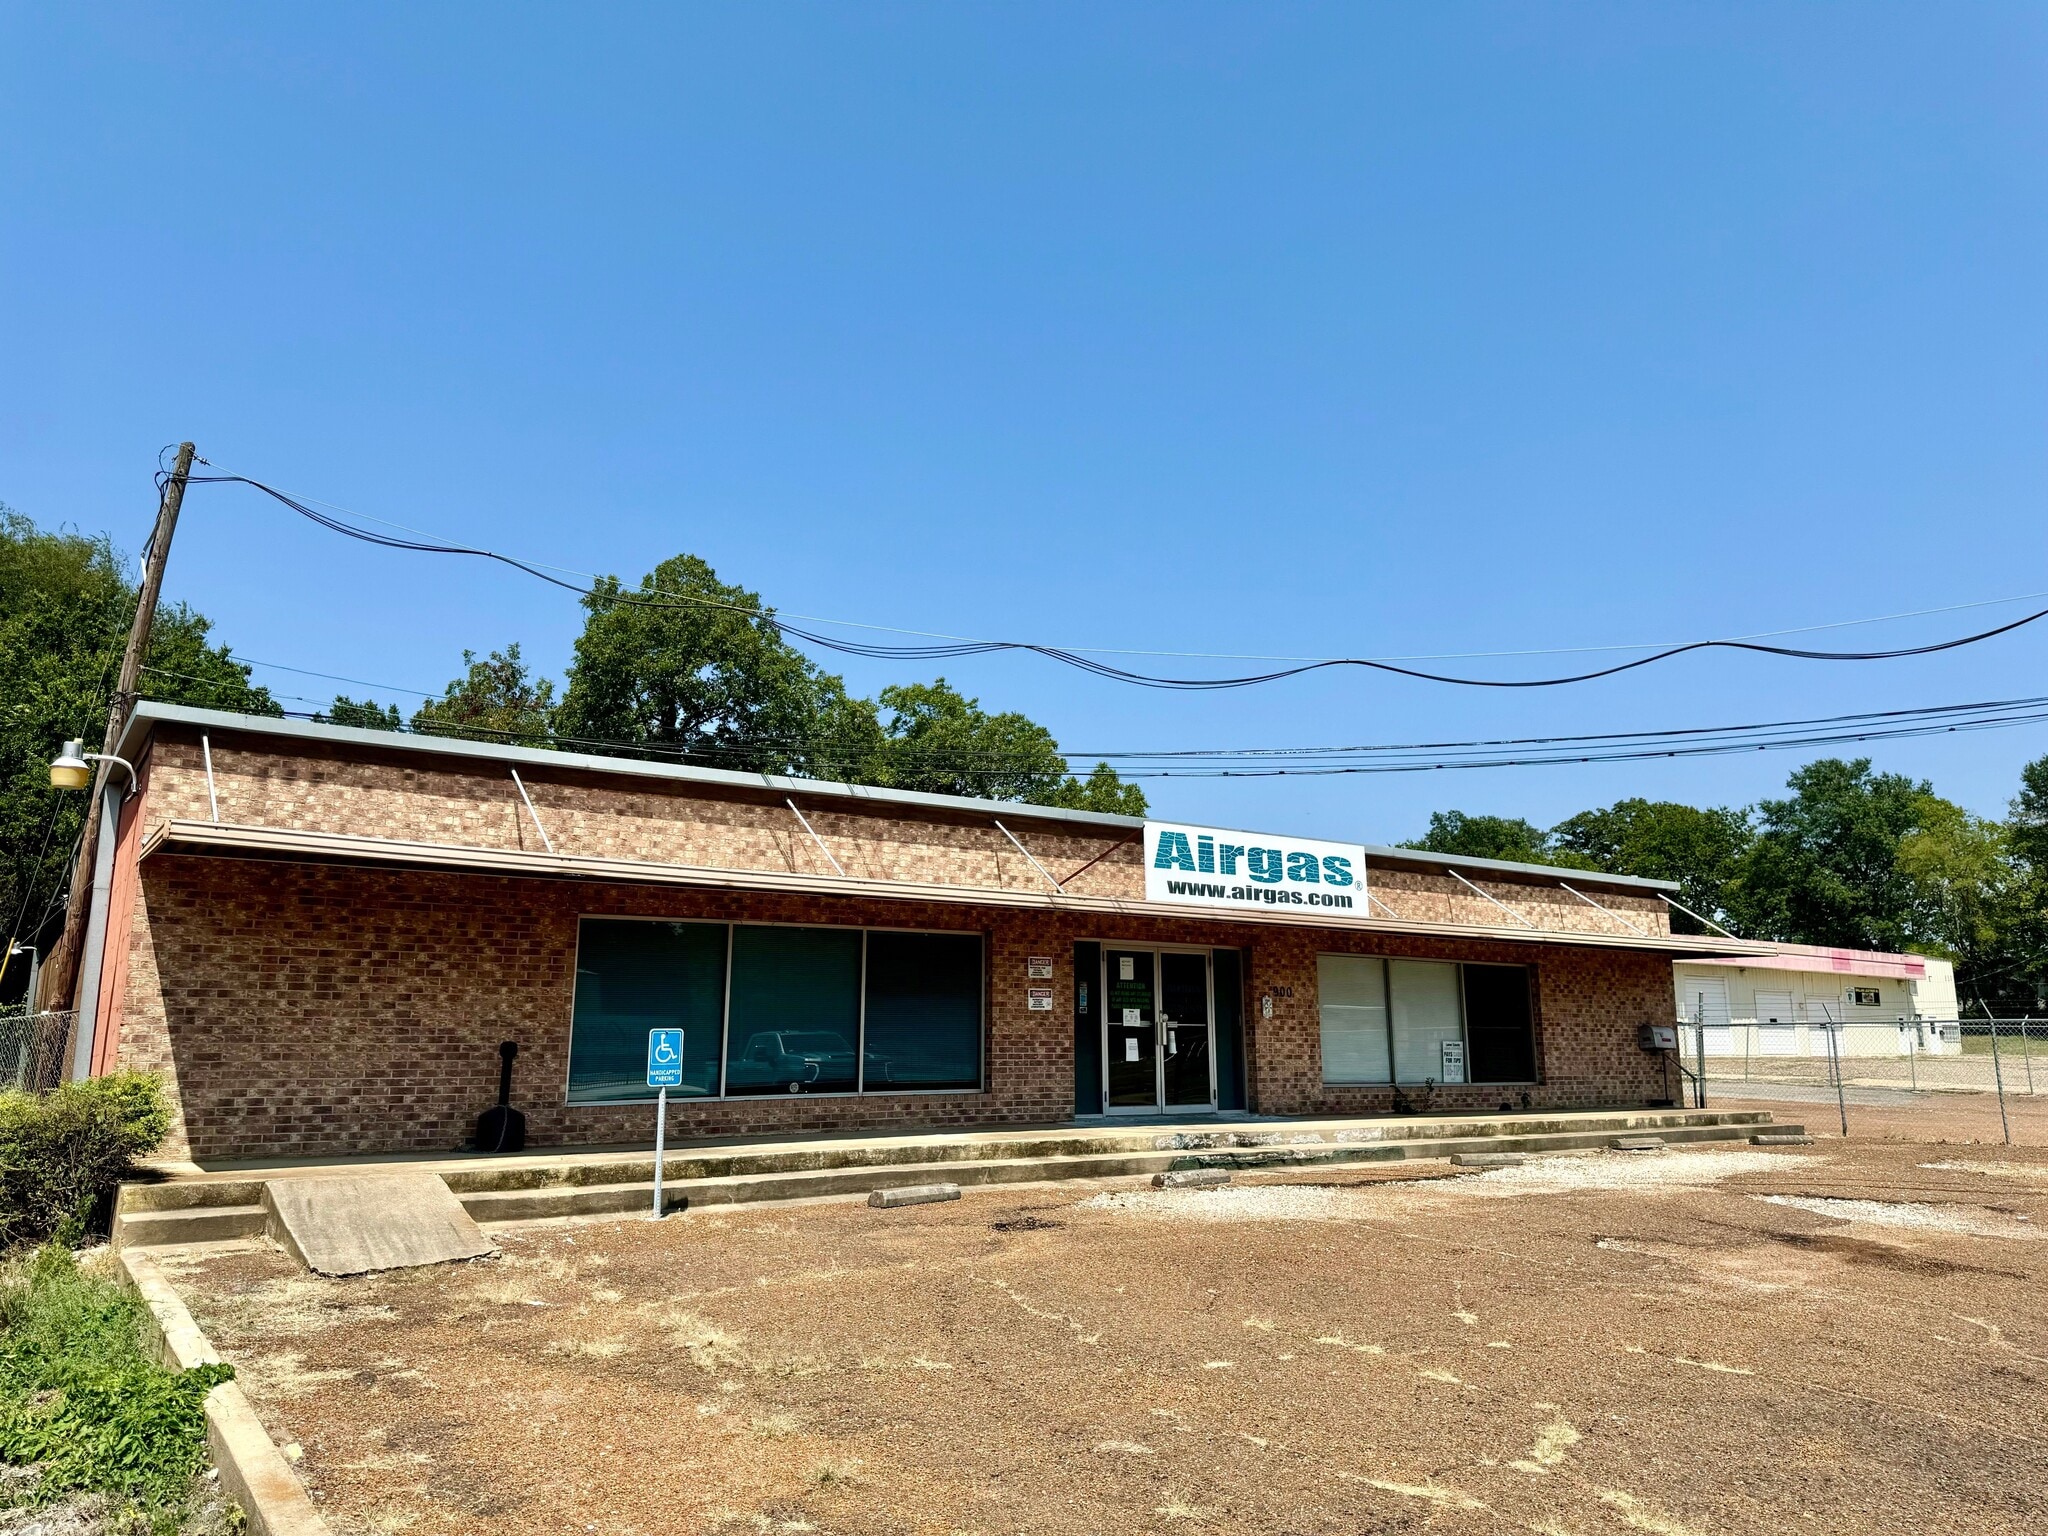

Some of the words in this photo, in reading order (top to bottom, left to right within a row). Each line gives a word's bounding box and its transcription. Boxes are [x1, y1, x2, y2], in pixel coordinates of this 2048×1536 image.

[1154, 830, 1354, 887] Airgas
[1167, 880, 1353, 909] www.airgas.com
[1273, 986, 1292, 998] 900
